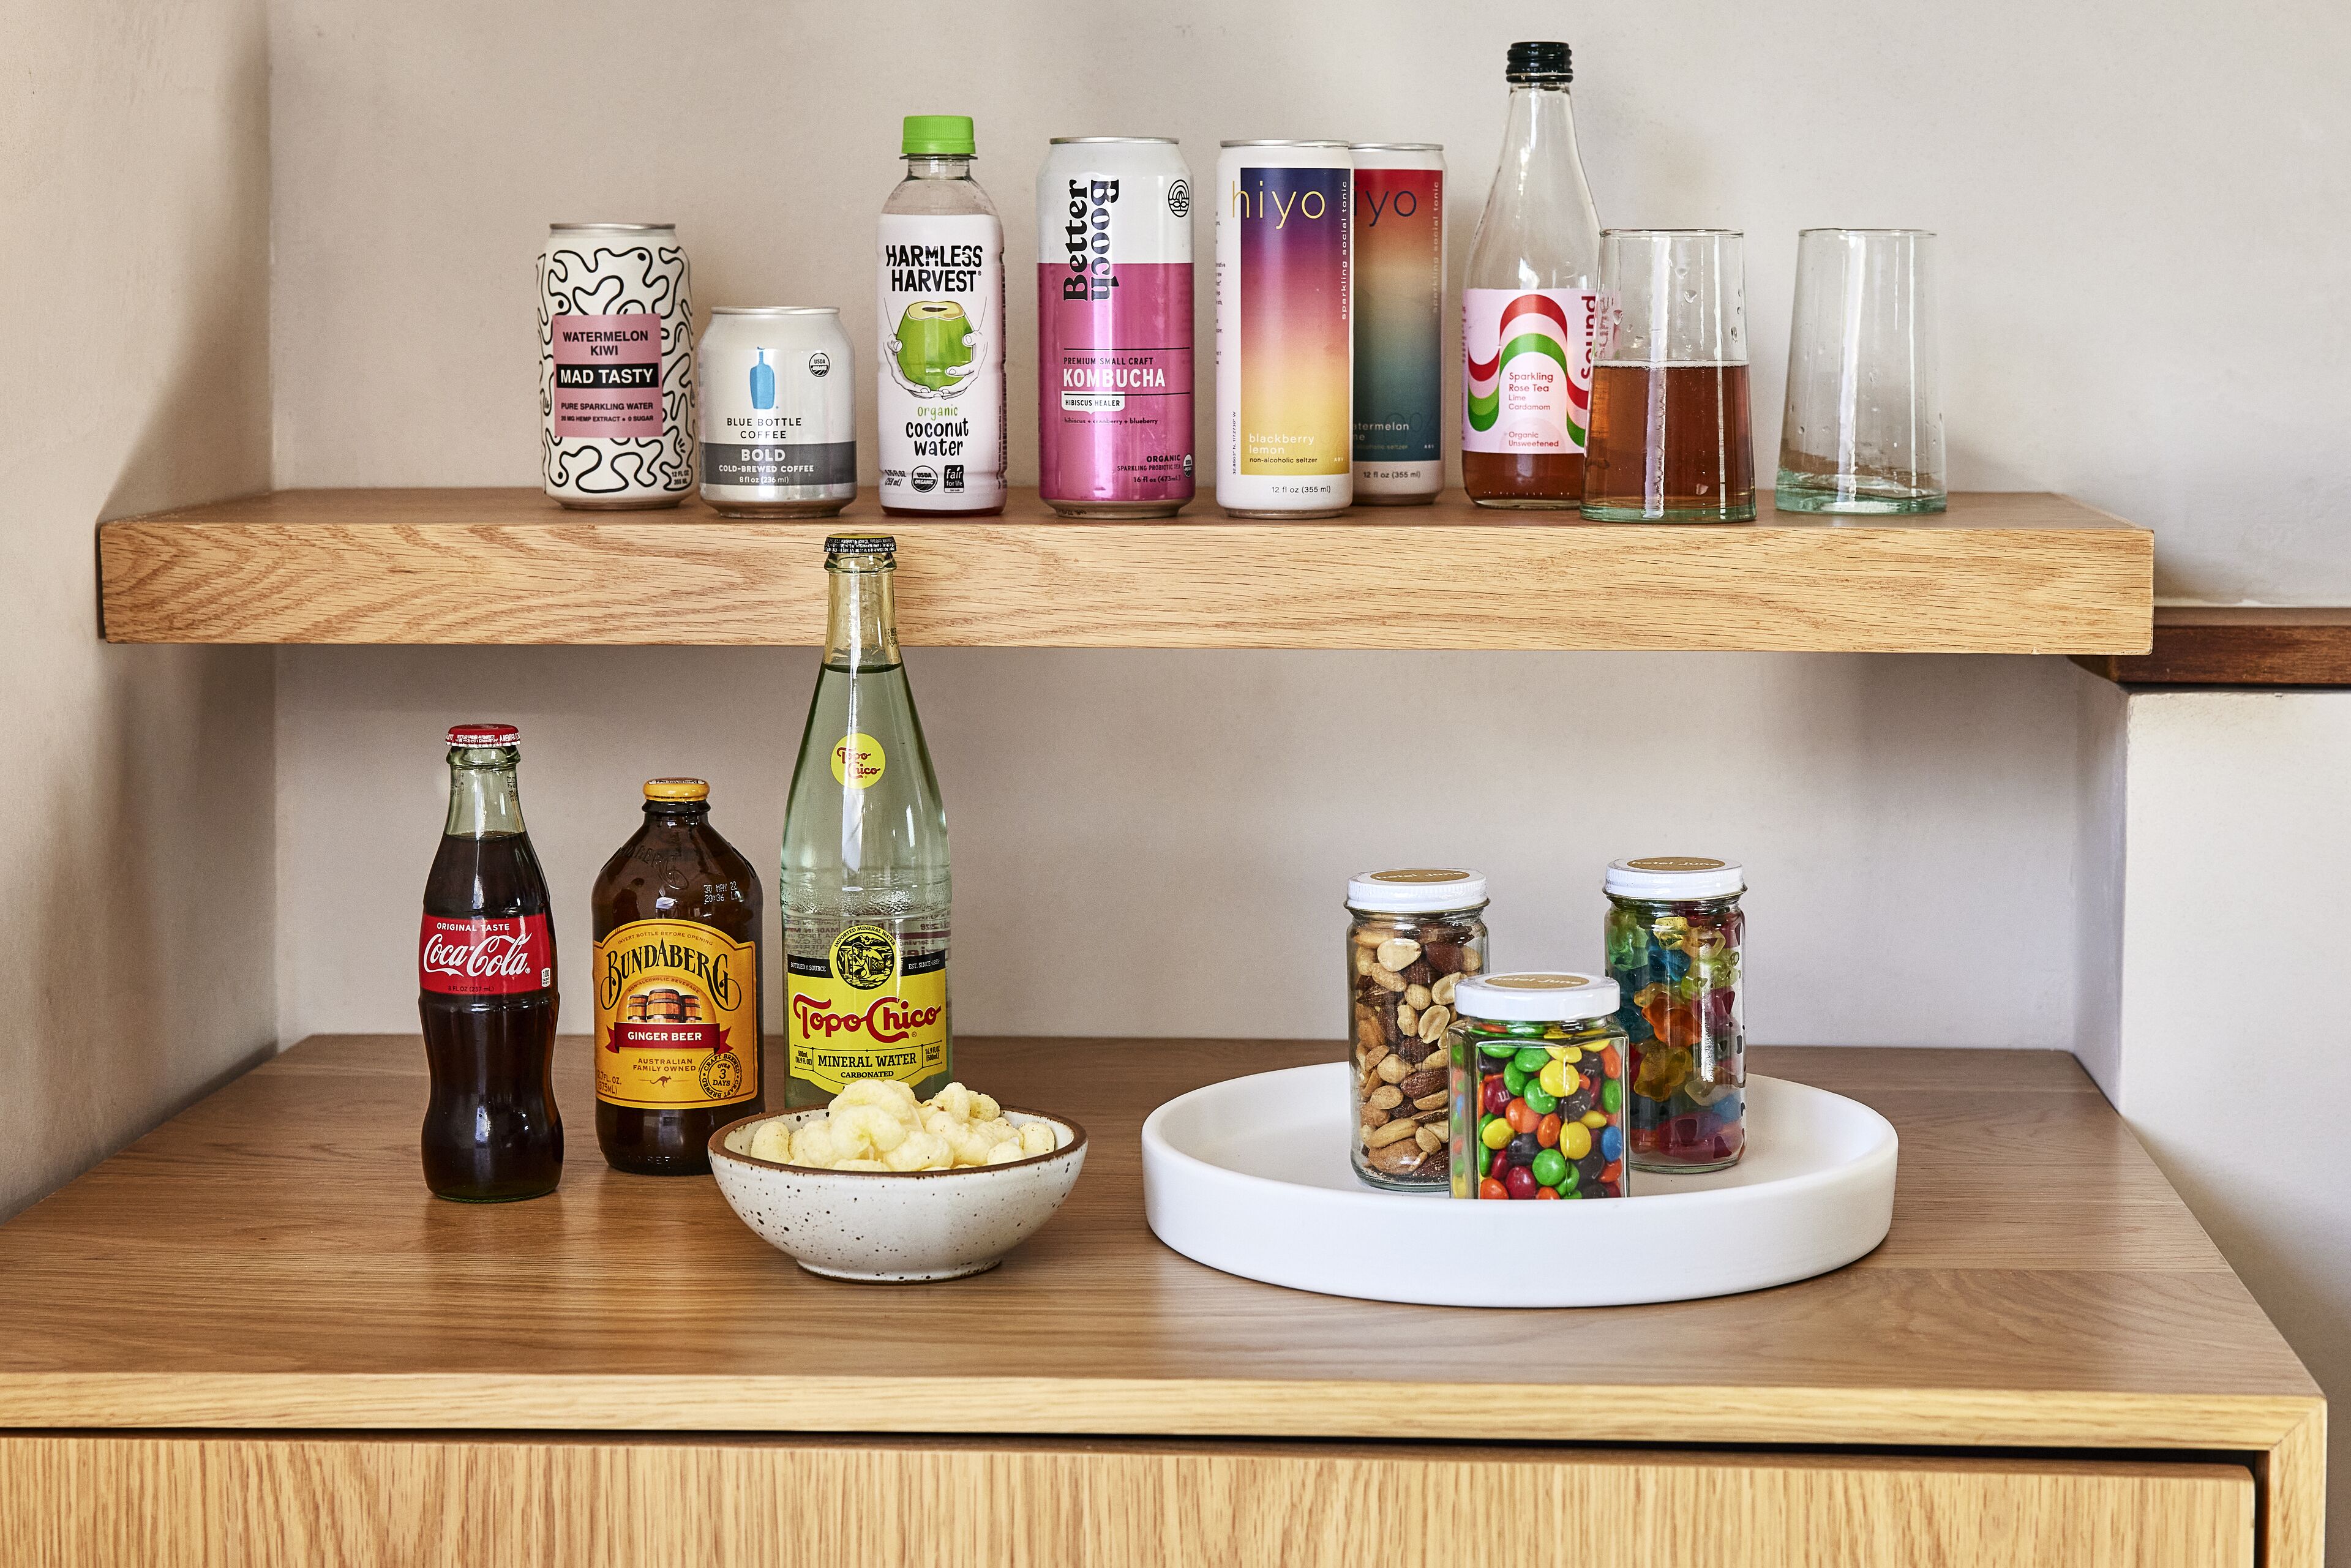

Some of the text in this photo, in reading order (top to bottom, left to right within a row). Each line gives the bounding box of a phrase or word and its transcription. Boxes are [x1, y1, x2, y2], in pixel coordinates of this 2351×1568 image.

[1232, 180, 1325, 230] hiyo
[1063, 179, 1087, 301] Better
[1091, 179, 1119, 301] Booch
[886, 245, 983, 267] HARMLESS
[891, 269, 976, 291] HARVEST
[563, 331, 648, 342] WATERMELON
[591, 345, 618, 356] KIWI
[561, 369, 653, 383] MAD TASTY
[1063, 369, 1166, 387] KOMBUCHA
[1509, 372, 1553, 383] Sparkling
[917, 404, 958, 420] organic
[906, 418, 969, 438] coconut
[914, 438, 962, 456] water
[1249, 433, 1314, 446] blackberry
[741, 449, 786, 462] BOLD
[1249, 445, 1284, 454] lemon
[947, 467, 962, 479] fair
[437, 922, 476, 932] ORIGINAL
[618, 935, 634, 944] INVERT
[687, 934, 713, 945] OPENING
[834, 928, 856, 948] IMPORTED
[882, 931, 896, 946] WATER
[424, 932, 532, 977] Coca-Cola
[600, 937, 741, 1011] BUNDABERG
[628, 978, 700, 993] NON-ALCOHOLIC BEVERAGE
[793, 994, 942, 1043] Topo Chico
[628, 1032, 702, 1041] GINGER BEER
[704, 1054, 740, 1074] CRAFT BREWED
[818, 1053, 917, 1068] MINERAL WATER
[719, 1069, 726, 1079] 3
[702, 1078, 738, 1098] CRAFT BREWED
